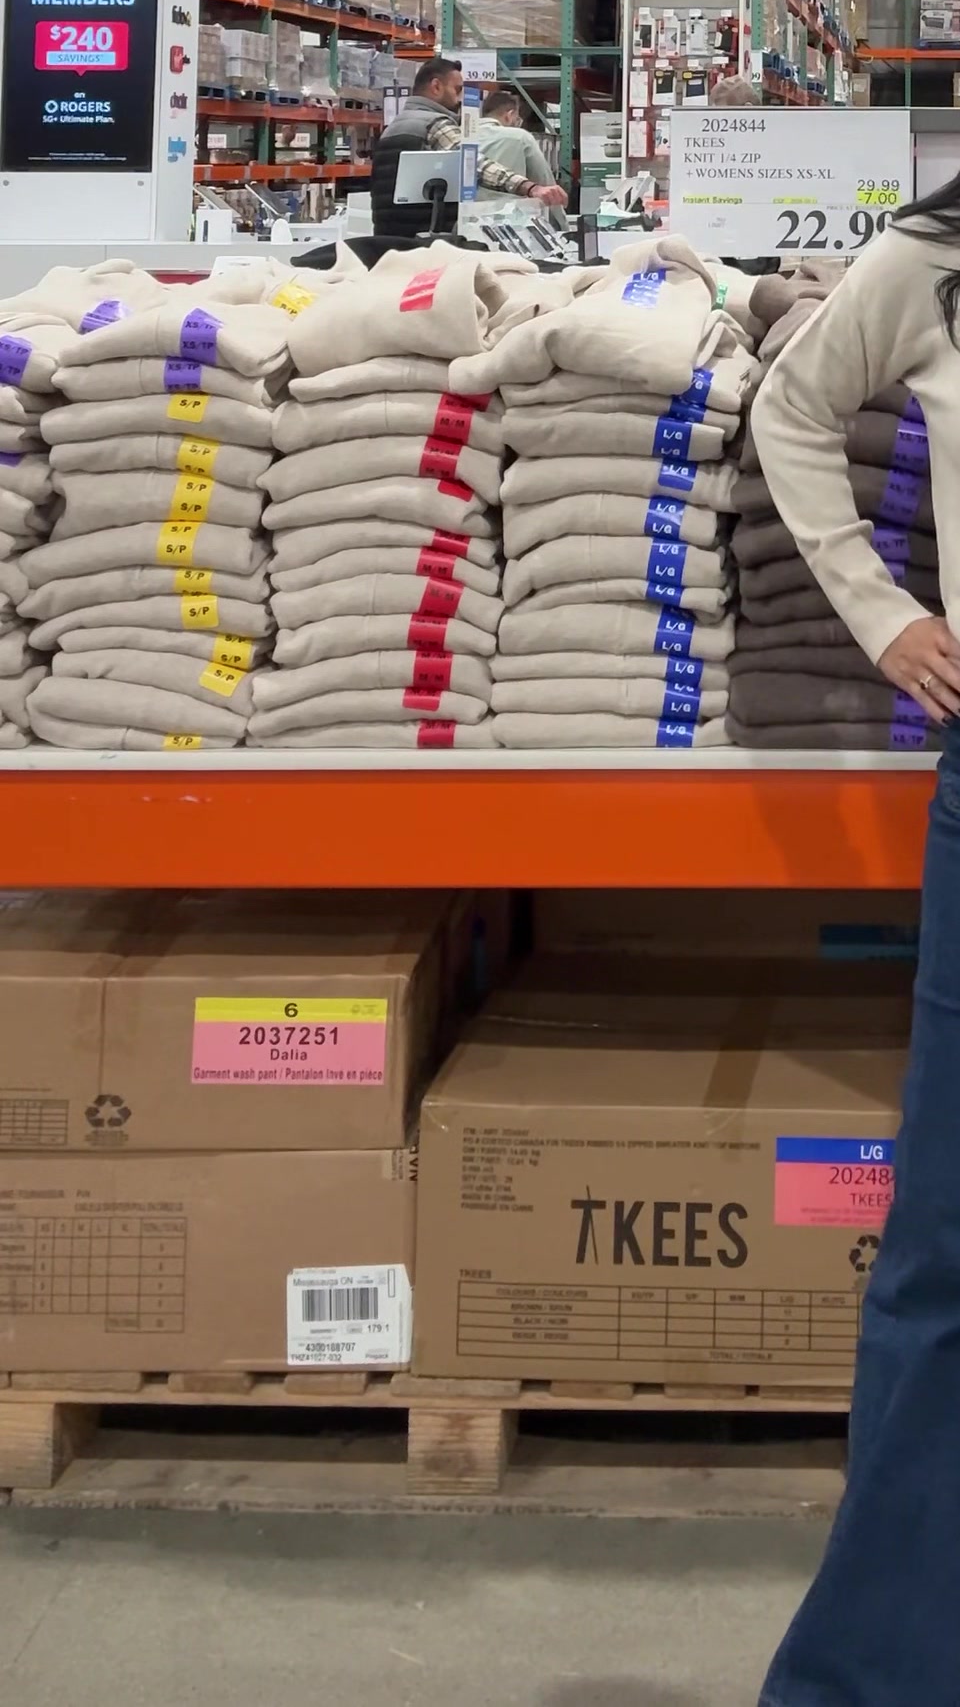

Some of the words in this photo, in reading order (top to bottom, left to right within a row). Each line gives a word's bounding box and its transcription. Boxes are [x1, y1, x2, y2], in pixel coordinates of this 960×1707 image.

[50, 25, 114, 50] $240
[60, 101, 111, 113] ROGERS
[702, 118, 766, 133] 2024844
[684, 137, 725, 148] TKEES
[684, 153, 715, 163] KNIT
[720, 153, 737, 163] 1/4
[741, 153, 761, 163] ZIP
[758, 168, 793, 179] SIZES
[796, 168, 836, 180] XS-XL
[857, 180, 900, 192] 29.99
[682, 196, 710, 204] Instant
[712, 196, 743, 205] Savings
[858, 193, 898, 205] -7.00
[640, 272, 659, 281] L/G
[183, 340, 214, 350] XS/TP
[168, 362, 199, 371] XS/TP
[180, 399, 200, 408] S/P
[663, 429, 683, 441] L/G
[190, 444, 210, 456] S/P
[661, 448, 680, 456] L/G
[669, 464, 689, 476] L/G
[187, 482, 207, 491] S/P
[180, 503, 202, 512] S/P
[656, 503, 676, 514] L/G
[652, 523, 672, 533] L/G
[166, 545, 186, 554] S/P
[659, 544, 679, 555] L/G
[184, 571, 205, 580] S/P
[655, 565, 675, 576] L/G
[655, 584, 675, 596] L/G
[189, 606, 210, 617] S/P
[665, 620, 686, 631] L/G
[662, 641, 682, 651] L/G
[221, 654, 241, 663] S/P
[674, 662, 695, 674] L/G
[214, 669, 235, 682] S/P
[671, 702, 691, 712] L/G
[665, 724, 686, 735] L/G
[173, 736, 193, 746] S/P
[284, 1002, 299, 1018] 6
[239, 1026, 339, 1046] 2037251
[270, 1048, 308, 1061] Dalia
[193, 1067, 230, 1080] Garment
[233, 1067, 256, 1079] wash
[258, 1067, 277, 1081] pant
[285, 1067, 324, 1081] Pantalon
[346, 1070, 356, 1080] en
[860, 1144, 883, 1160] L/G
[829, 1166, 896, 1186] 20248
[571, 1186, 748, 1269] TKEES
